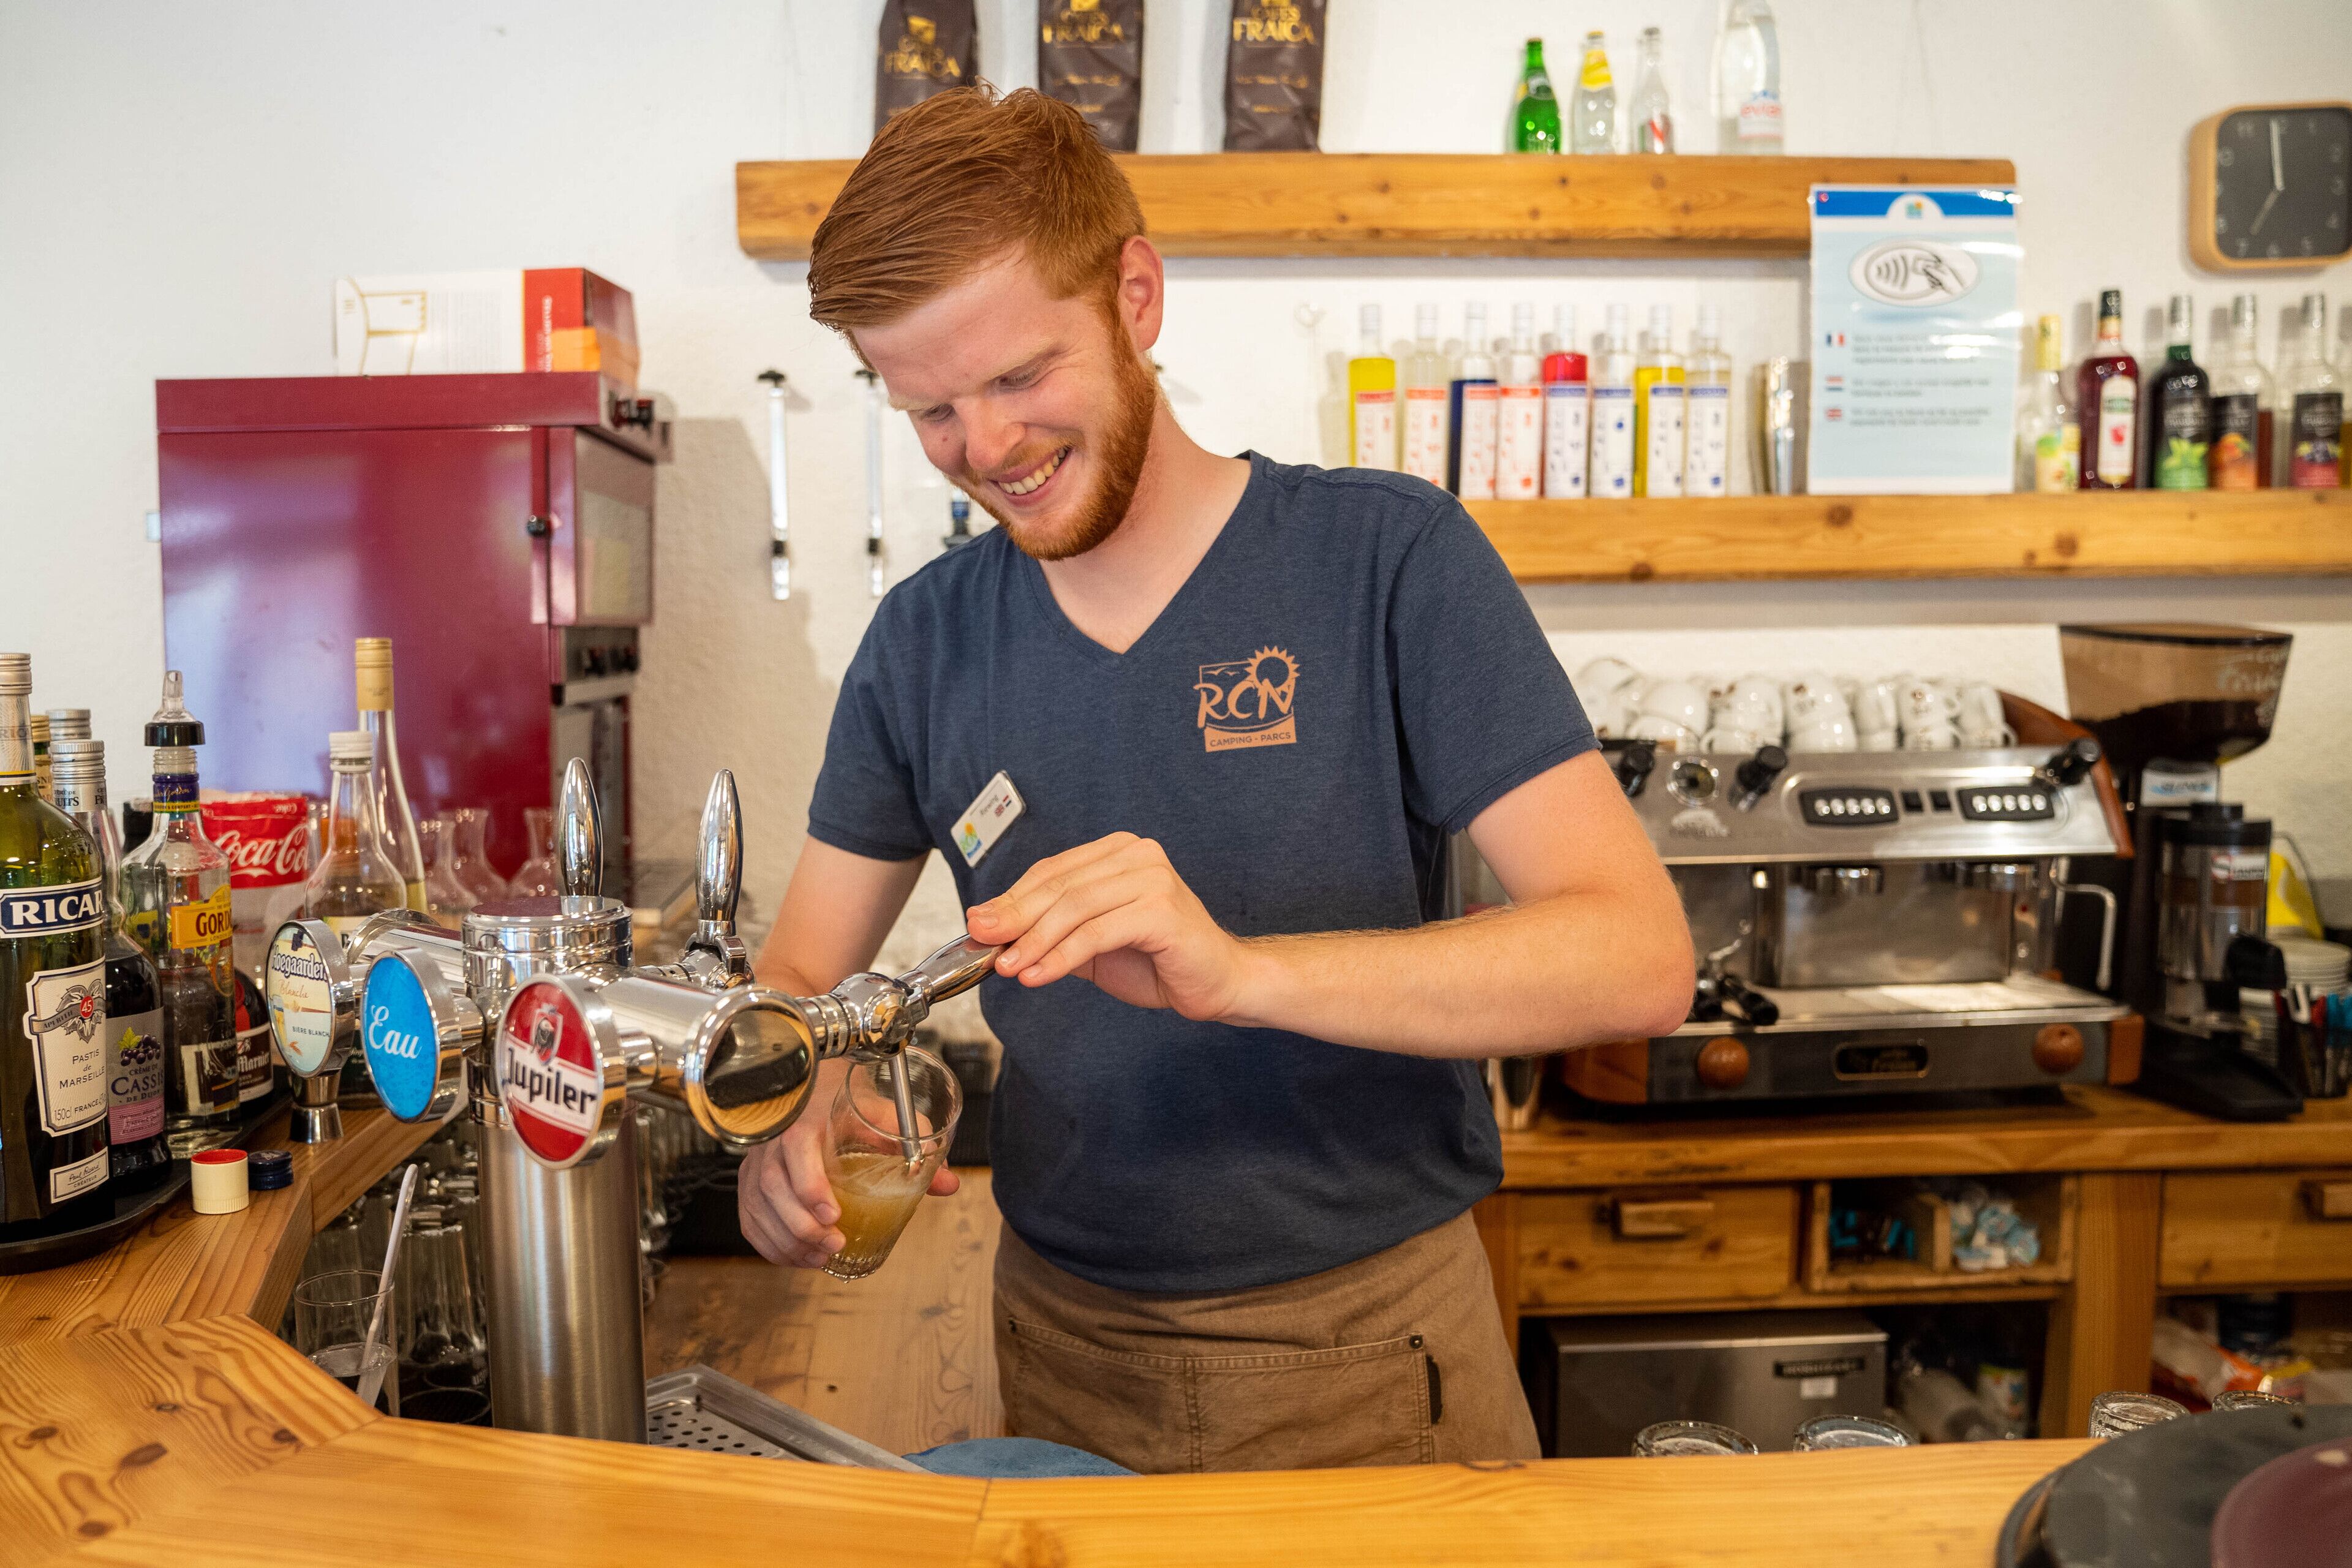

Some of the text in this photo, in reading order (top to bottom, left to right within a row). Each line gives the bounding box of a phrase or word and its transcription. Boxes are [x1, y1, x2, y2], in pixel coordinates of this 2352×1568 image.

[1193, 678, 1296, 729] RCN
[1210, 736, 1253, 747] CAMPING
[1261, 732, 1291, 743] PARCS
[214, 823, 308, 875] Coca-Co
[10, 889, 104, 925] RICAR
[81, 1000, 92, 1013] 45
[308, 1029, 331, 1038] BLANCH
[369, 1005, 423, 1059] Eau
[72, 1049, 100, 1065] PASTIS
[59, 1066, 105, 1090] MARSEILLE
[501, 1047, 597, 1114] Jupiler
[54, 1098, 99, 1121] 150cl FRANCE
